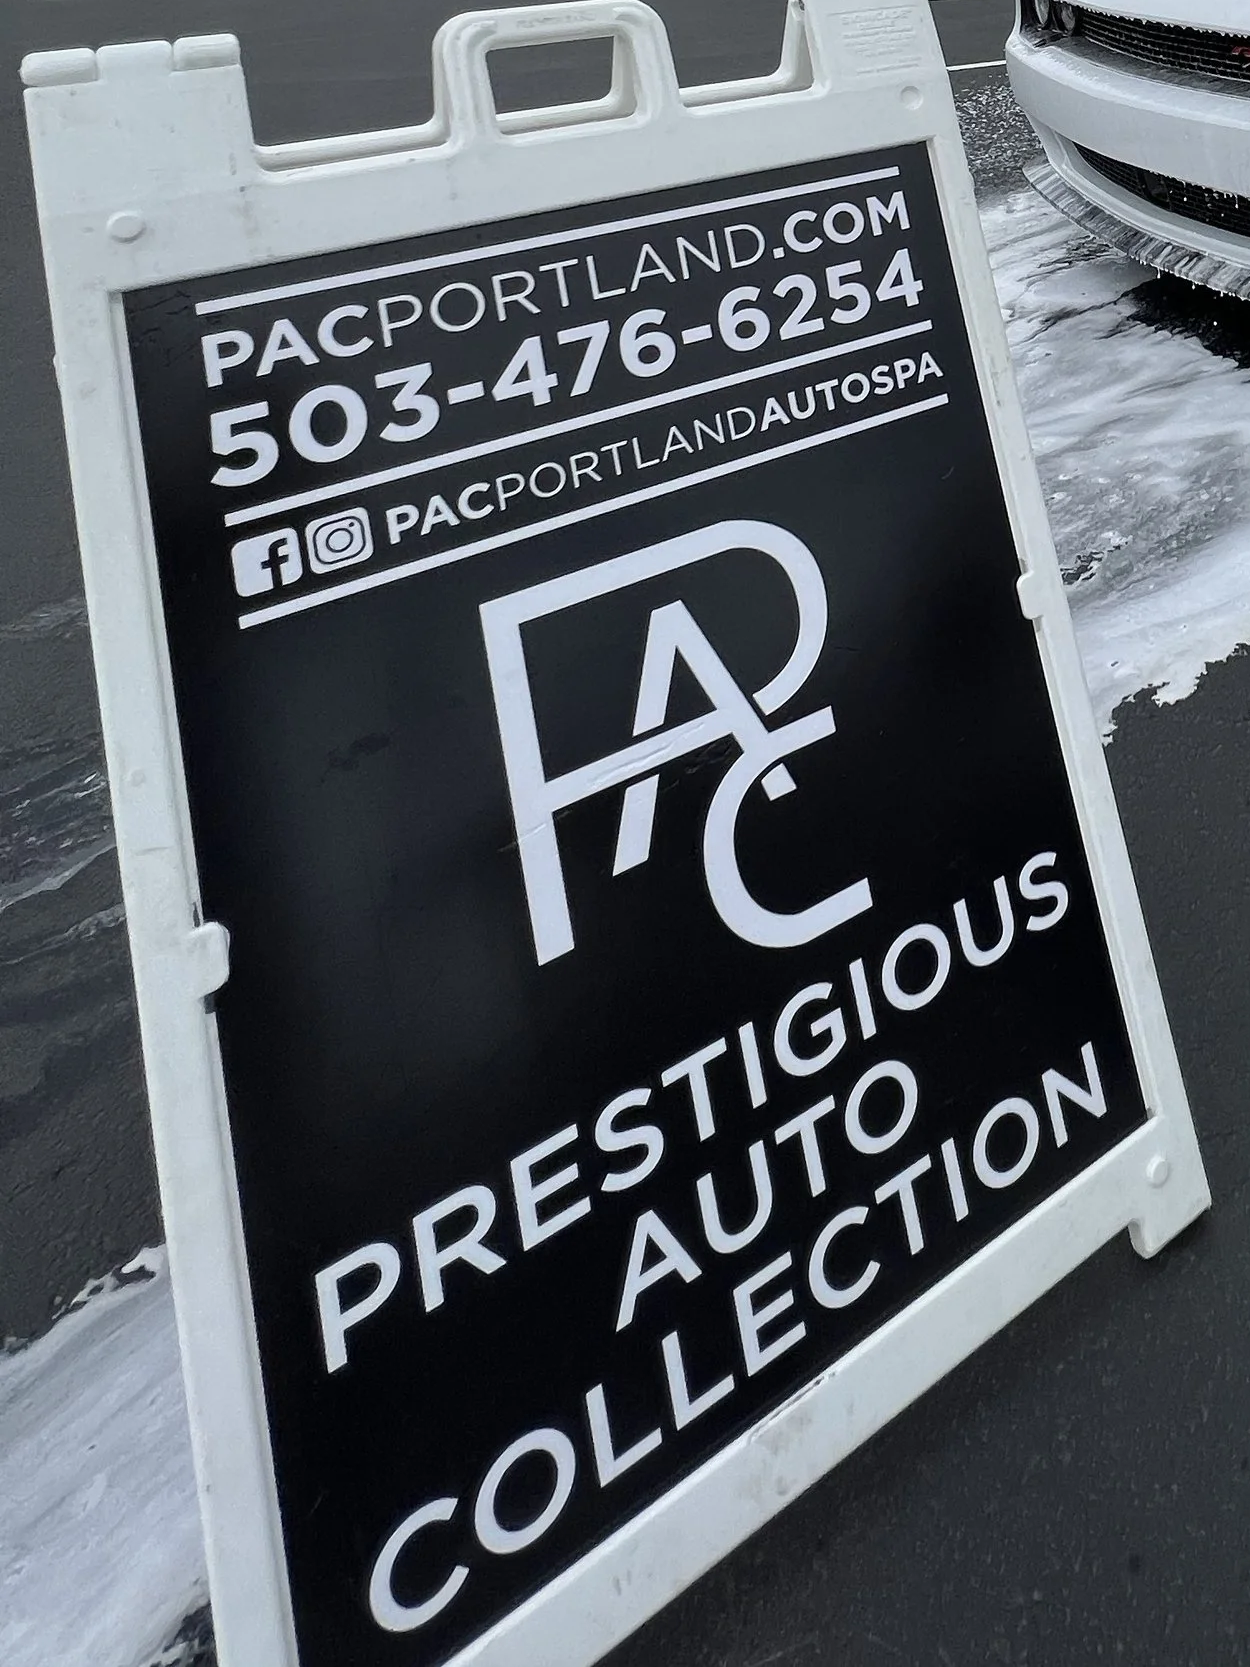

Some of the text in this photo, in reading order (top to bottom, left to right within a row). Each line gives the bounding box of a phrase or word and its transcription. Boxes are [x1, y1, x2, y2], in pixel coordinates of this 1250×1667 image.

[200, 190, 912, 388] PACPORTLAND.COM
[210, 248, 924, 487] 503-476-6254
[385, 351, 944, 545] PACPORTLANDAUTOSPA
[314, 851, 1069, 1374] PRESTIGIOUS
[615, 1060, 918, 1332] AUTO
[369, 1041, 1107, 1632] COLLECTION
